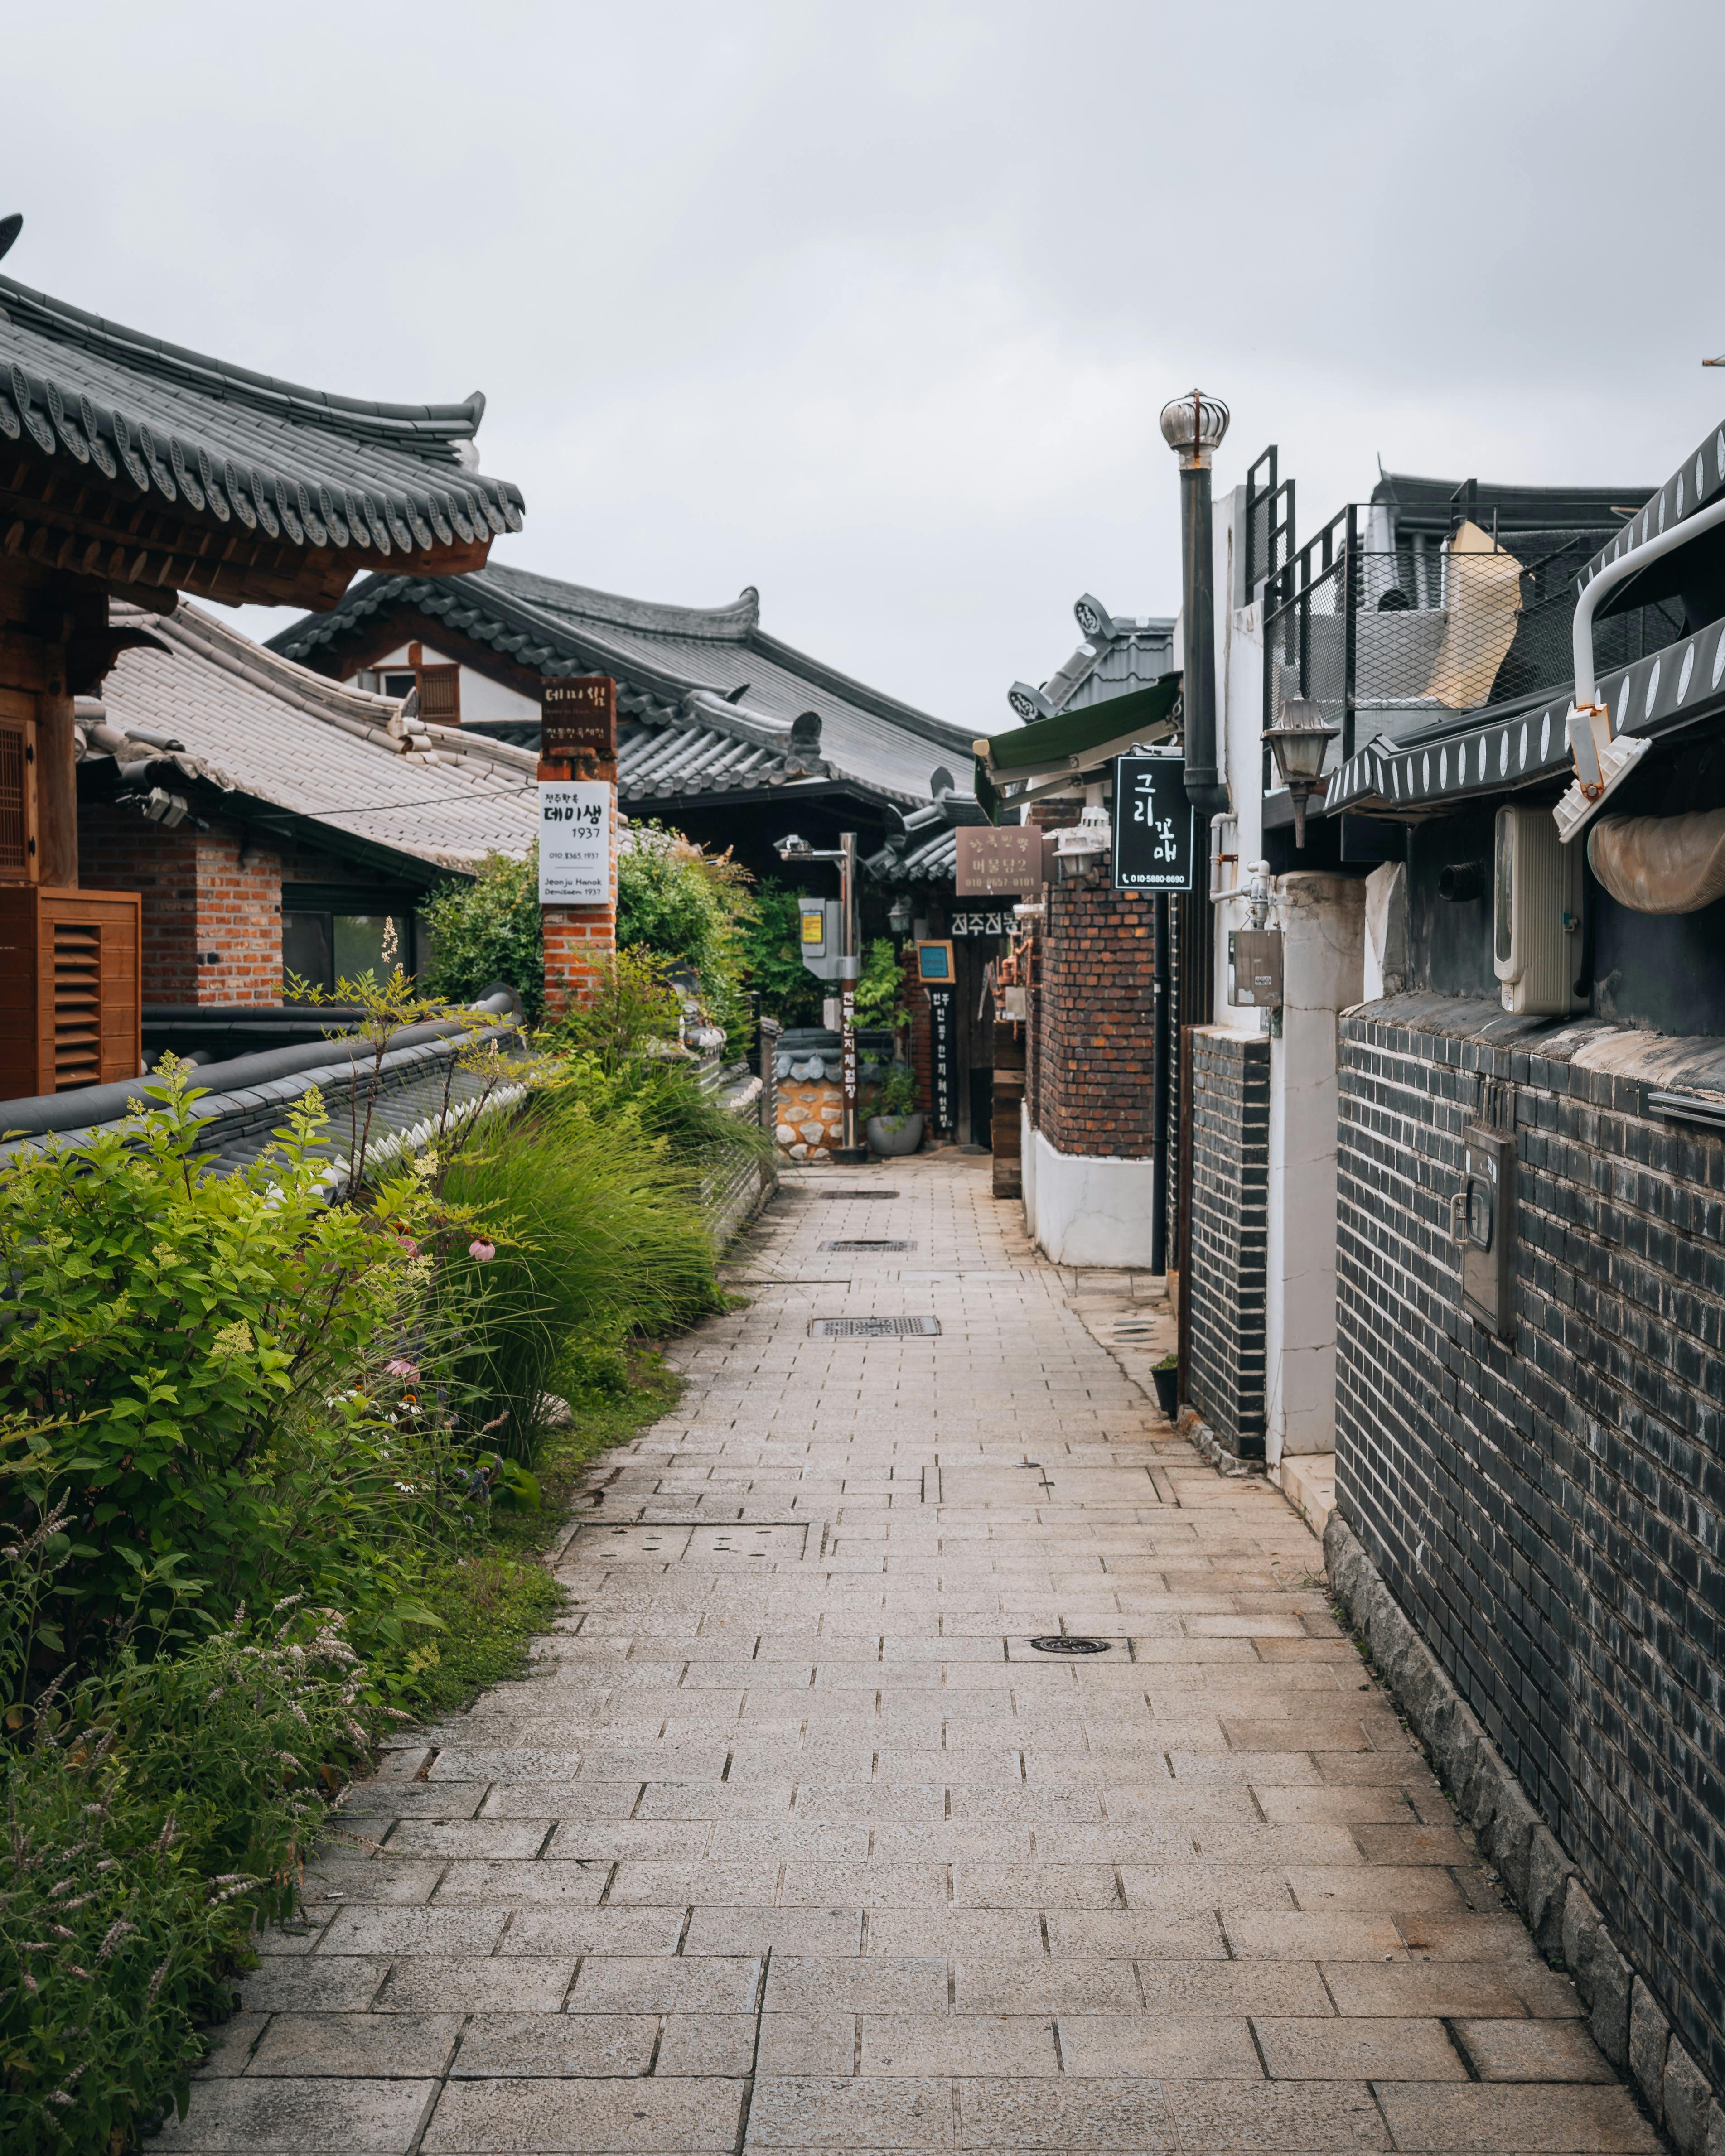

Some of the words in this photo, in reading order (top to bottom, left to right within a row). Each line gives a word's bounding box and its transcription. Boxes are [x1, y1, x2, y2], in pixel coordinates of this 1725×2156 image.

[572, 828, 600, 839] 1937
[545, 878, 572, 887] Jeonju
[1131, 875, 1184, 883] 010-5880-8690
